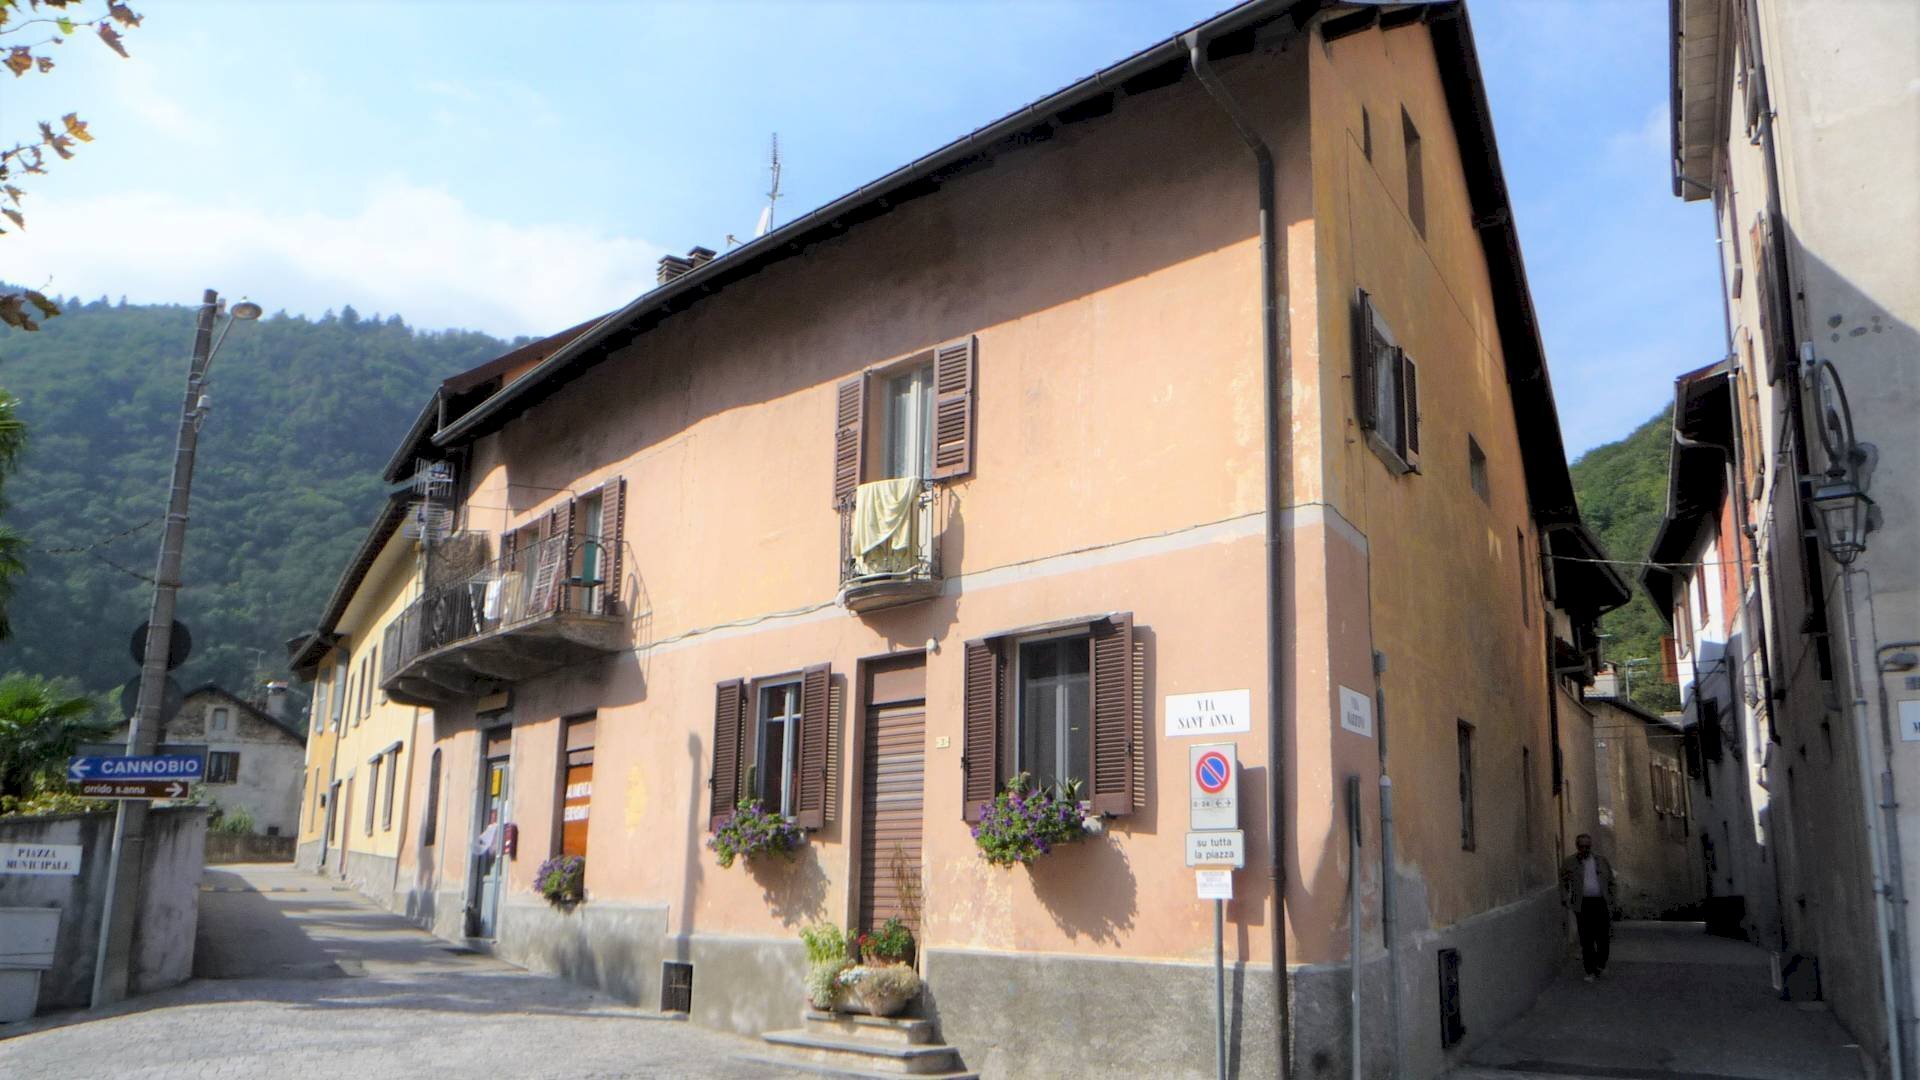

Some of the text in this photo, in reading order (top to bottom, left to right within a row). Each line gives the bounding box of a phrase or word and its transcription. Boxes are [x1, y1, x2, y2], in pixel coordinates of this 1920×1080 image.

[1196, 699, 1215, 711] VIA
[1208, 713, 1235, 727] ANNA
[101, 760, 199, 774] CANNOBIO
[83, 784, 113, 794] orrido
[1210, 838, 1232, 847] tutta
[17, 848, 57, 858] PIAZZA
[1194, 850, 1235, 860] la piazza
[6, 860, 71, 870] MUNICIPALE
